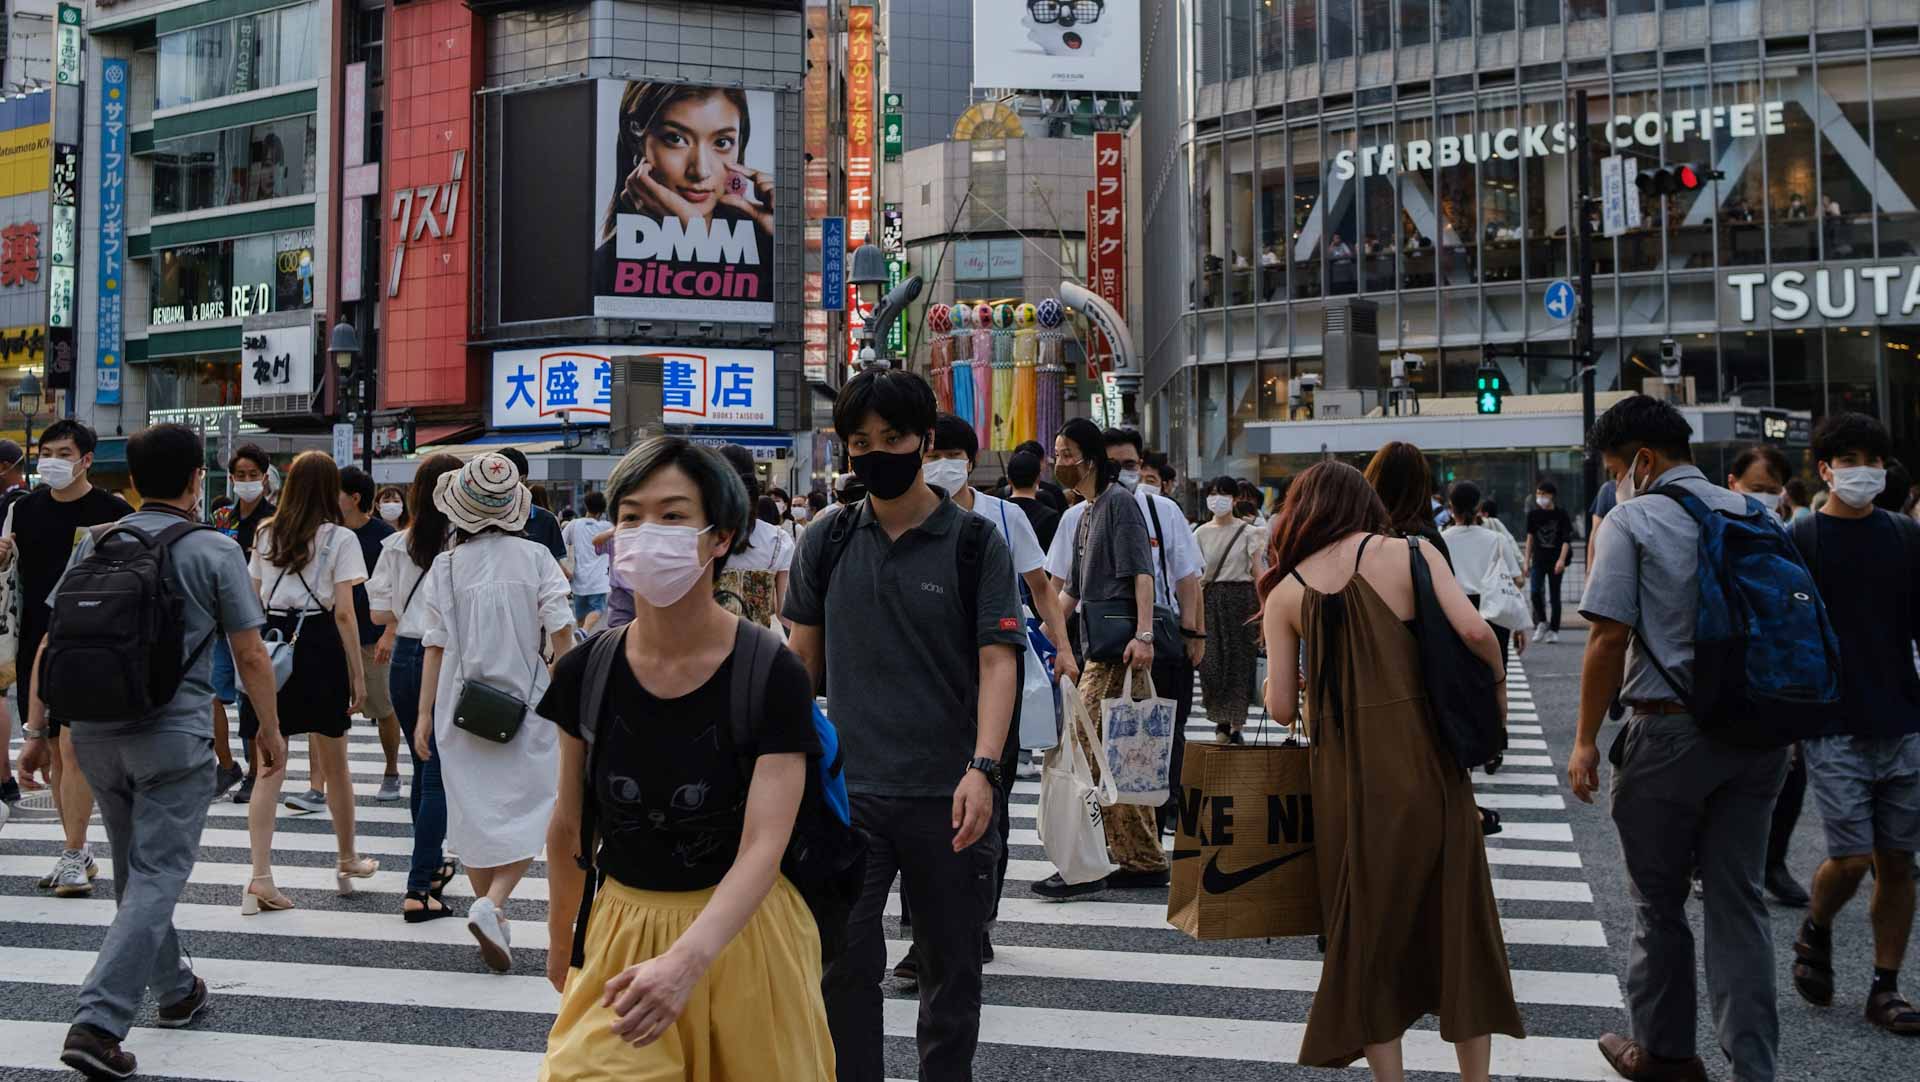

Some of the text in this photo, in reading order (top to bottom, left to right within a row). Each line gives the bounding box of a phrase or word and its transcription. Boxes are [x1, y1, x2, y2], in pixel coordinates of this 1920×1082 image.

[849, 12, 871, 240] クスリのことなら 三千里
[1335, 101, 1786, 181] STARBUCKS COFFEE
[102, 102, 123, 276] サマーフルーツギフト
[1098, 147, 1121, 256] カラオケ
[616, 212, 760, 265] DMM
[200, 300, 225, 321] DARTS
[614, 261, 760, 298] Bitcoin
